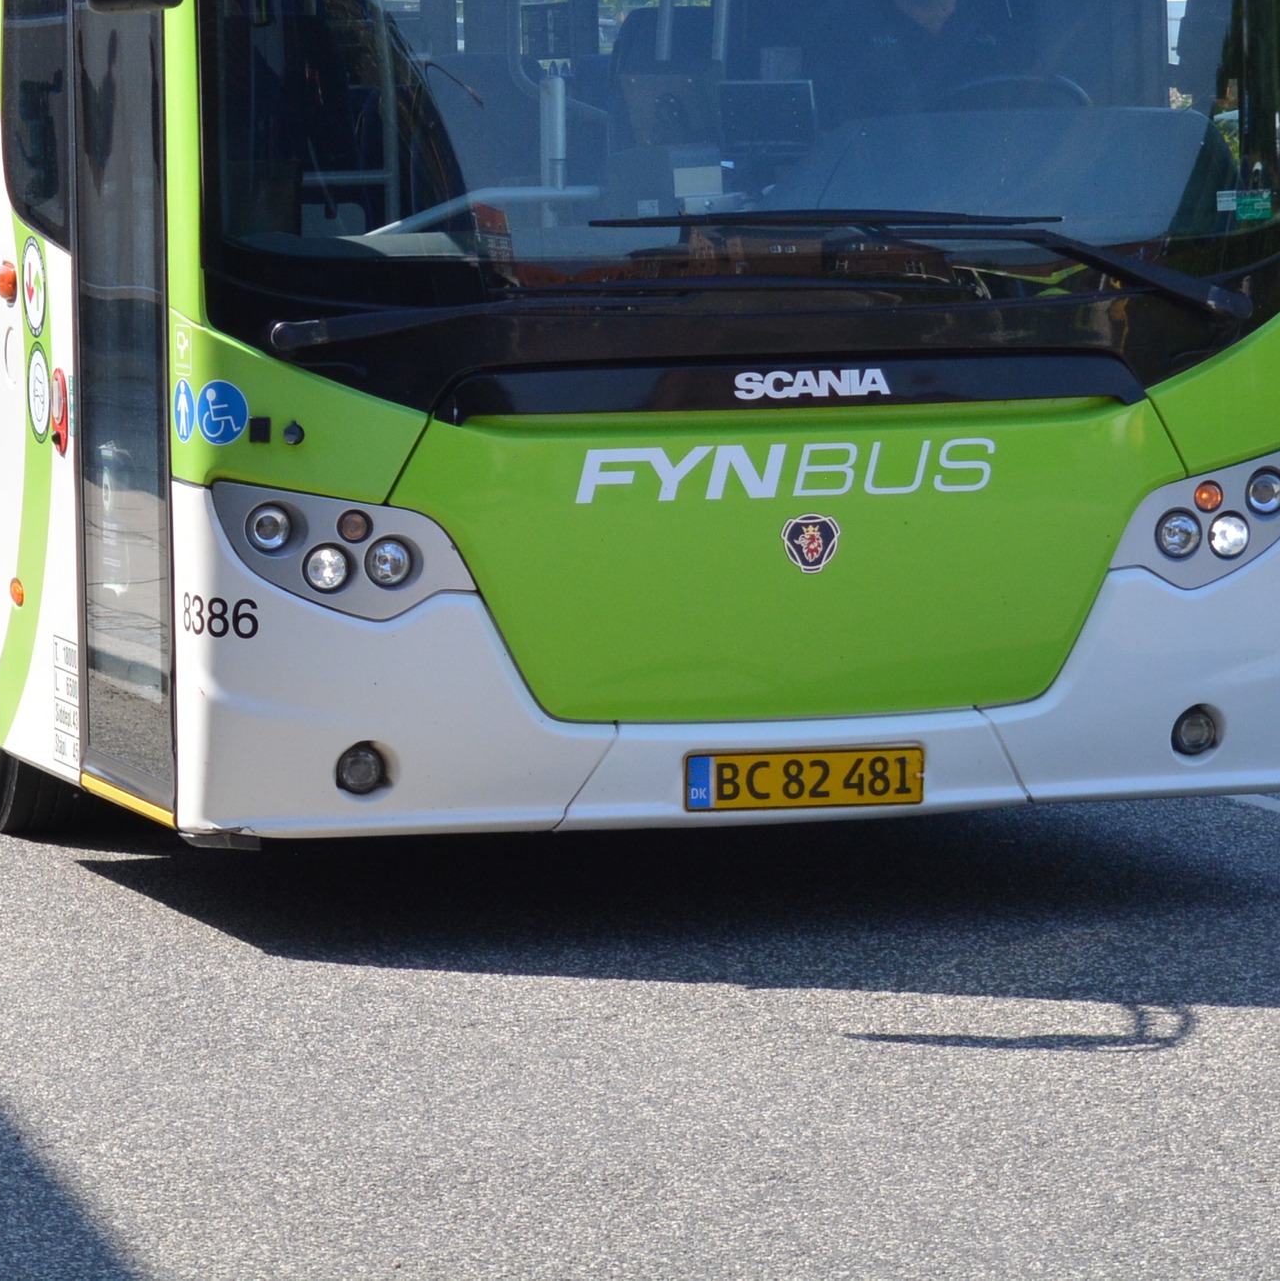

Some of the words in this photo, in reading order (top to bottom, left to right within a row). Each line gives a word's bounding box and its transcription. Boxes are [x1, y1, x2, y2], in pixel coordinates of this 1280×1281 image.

[733, 367, 892, 401] SCANIA
[574, 437, 996, 504] FYNBUS
[183, 591, 259, 639] 8386
[690, 787, 708, 800] DK
[716, 760, 771, 801] BC
[781, 758, 830, 799] 82
[842, 755, 912, 797] 481
